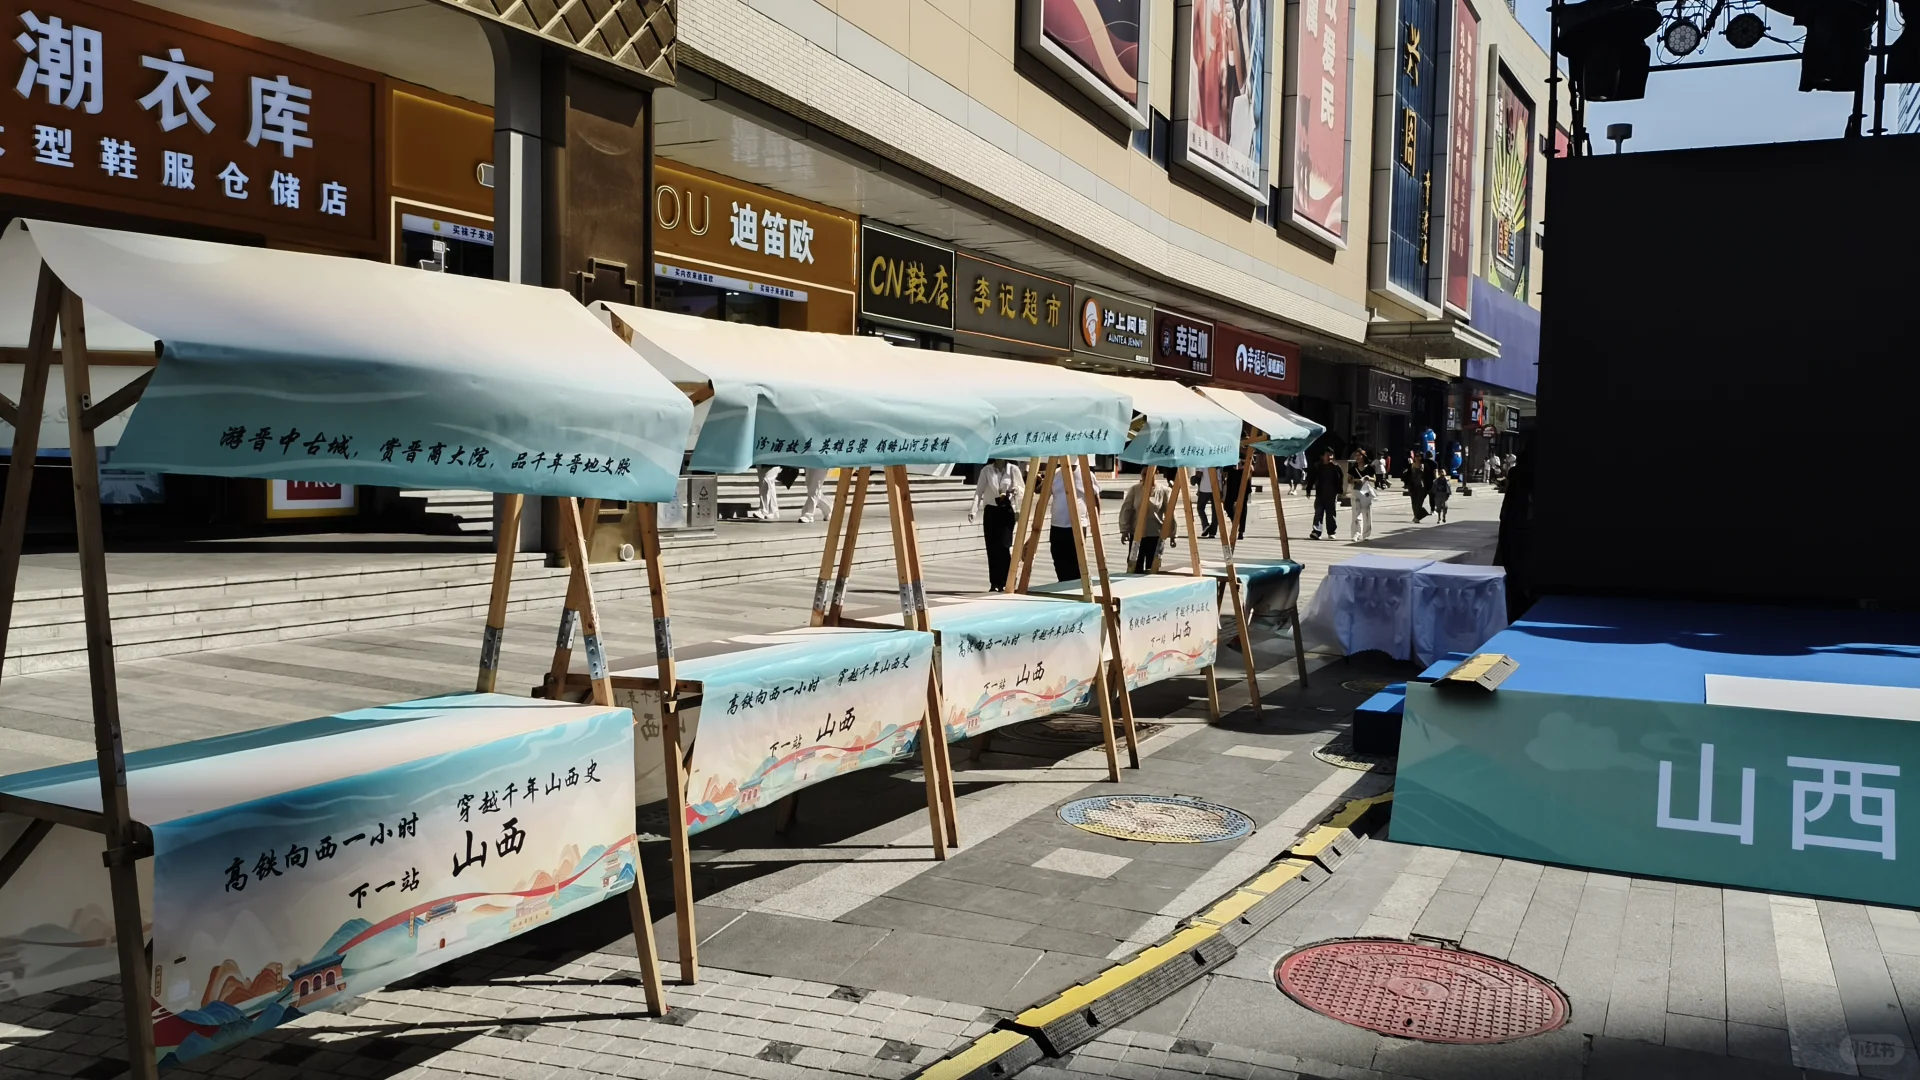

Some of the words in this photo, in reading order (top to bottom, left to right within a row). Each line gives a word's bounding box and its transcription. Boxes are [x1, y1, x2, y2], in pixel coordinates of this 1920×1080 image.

[12, 9, 314, 159] 潮衣库
[0, 124, 348, 217] 型鞋服仓储店
[729, 201, 815, 265] 迪笛欧
[674, 268, 714, 283] 买内衣来迪笛欧
[869, 255, 949, 310] CN鞋店
[973, 276, 1061, 327] 李记超市
[1103, 309, 1147, 336] 沪上阿姨
[1107, 332, 1127, 345] AUNTEA
[1175, 324, 1208, 359] 幸运咖
[511, 451, 631, 476] 品千年晋地文脉
[756, 436, 814, 455] 汾酒故乡
[819, 437, 868, 455] 英雄吕梁
[875, 436, 951, 454] 领略山河与豪情
[958, 632, 1021, 659] 高铁向西一小时
[1031, 619, 1085, 644] 穿越千年山西史
[1172, 620, 1192, 642] 山西
[726, 675, 820, 716] 高铁向西一小时
[837, 652, 912, 687] 穿越千年山西史
[983, 677, 1007, 694] 下一站
[1016, 660, 1045, 688] 山西
[768, 733, 803, 758] 下一站
[815, 706, 856, 743] 山西
[223, 811, 421, 894] 高铁向西一小时
[456, 758, 602, 824] 穿越千年山西史
[1656, 743, 1900, 861] 山西
[348, 866, 422, 910] 下一站
[452, 816, 526, 878] 山西
